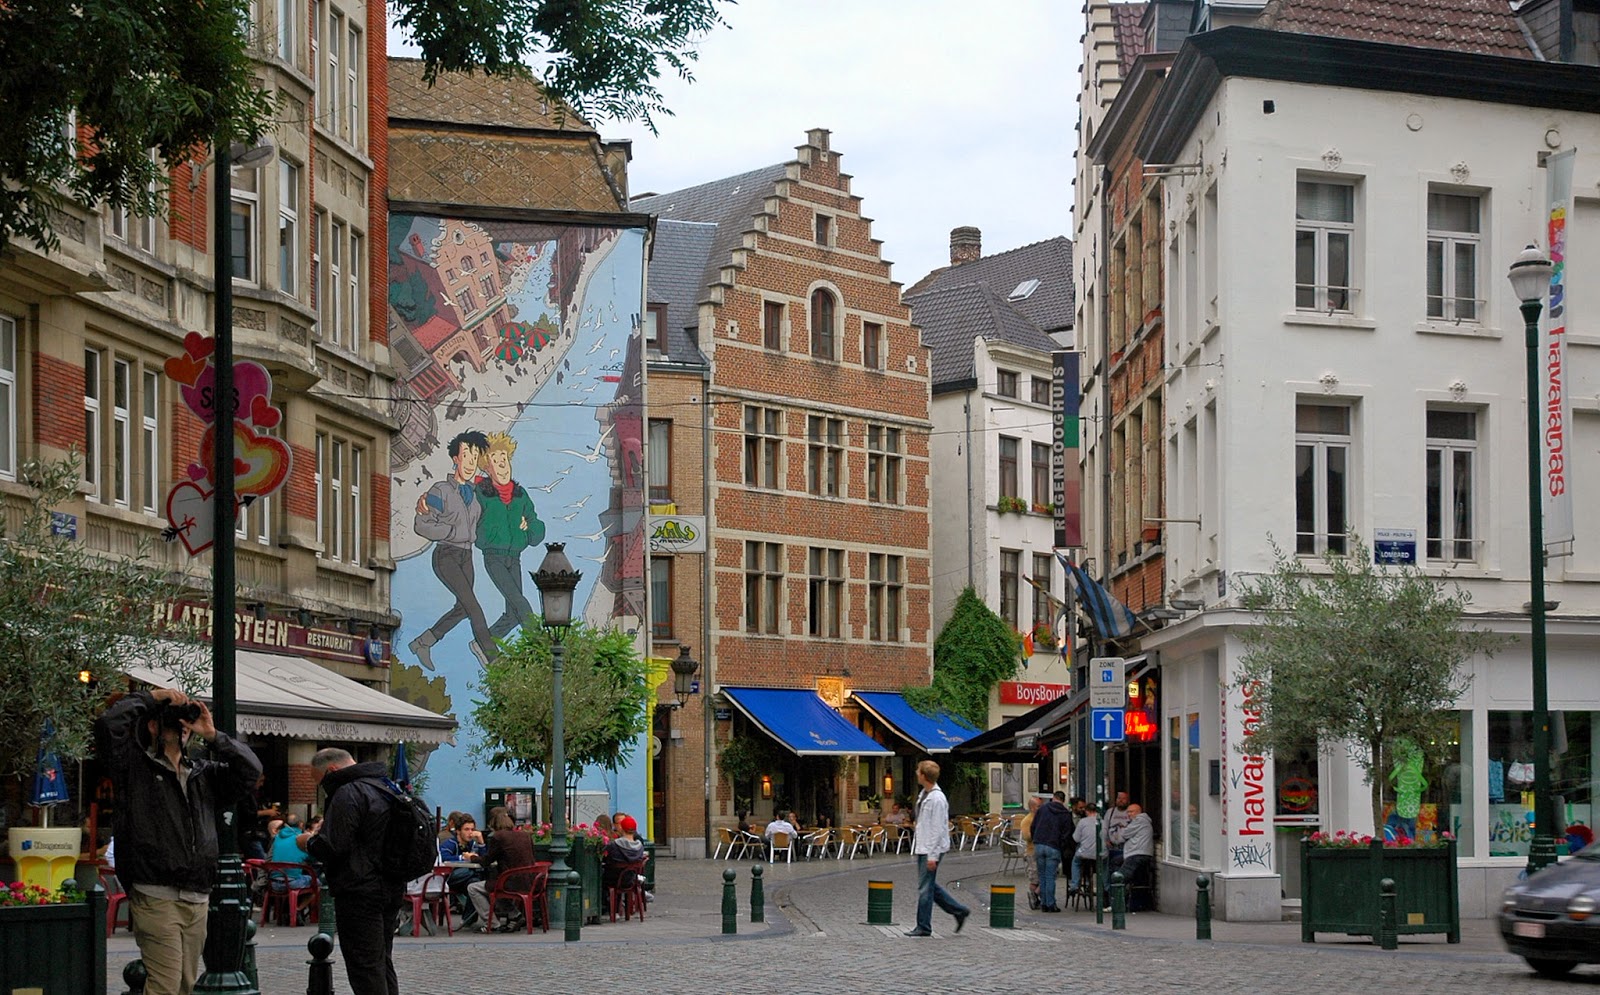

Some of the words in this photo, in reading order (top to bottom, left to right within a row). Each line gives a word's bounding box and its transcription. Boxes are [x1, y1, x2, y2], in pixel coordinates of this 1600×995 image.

[1546, 326, 1565, 497] havaianas
[1053, 365, 1066, 531] REGENBOOGHUIS
[307, 632, 354, 652] RESTAURANT
[242, 717, 285, 732] GRIMBERGEN
[322, 724, 356, 736] GRIMBERGEN
